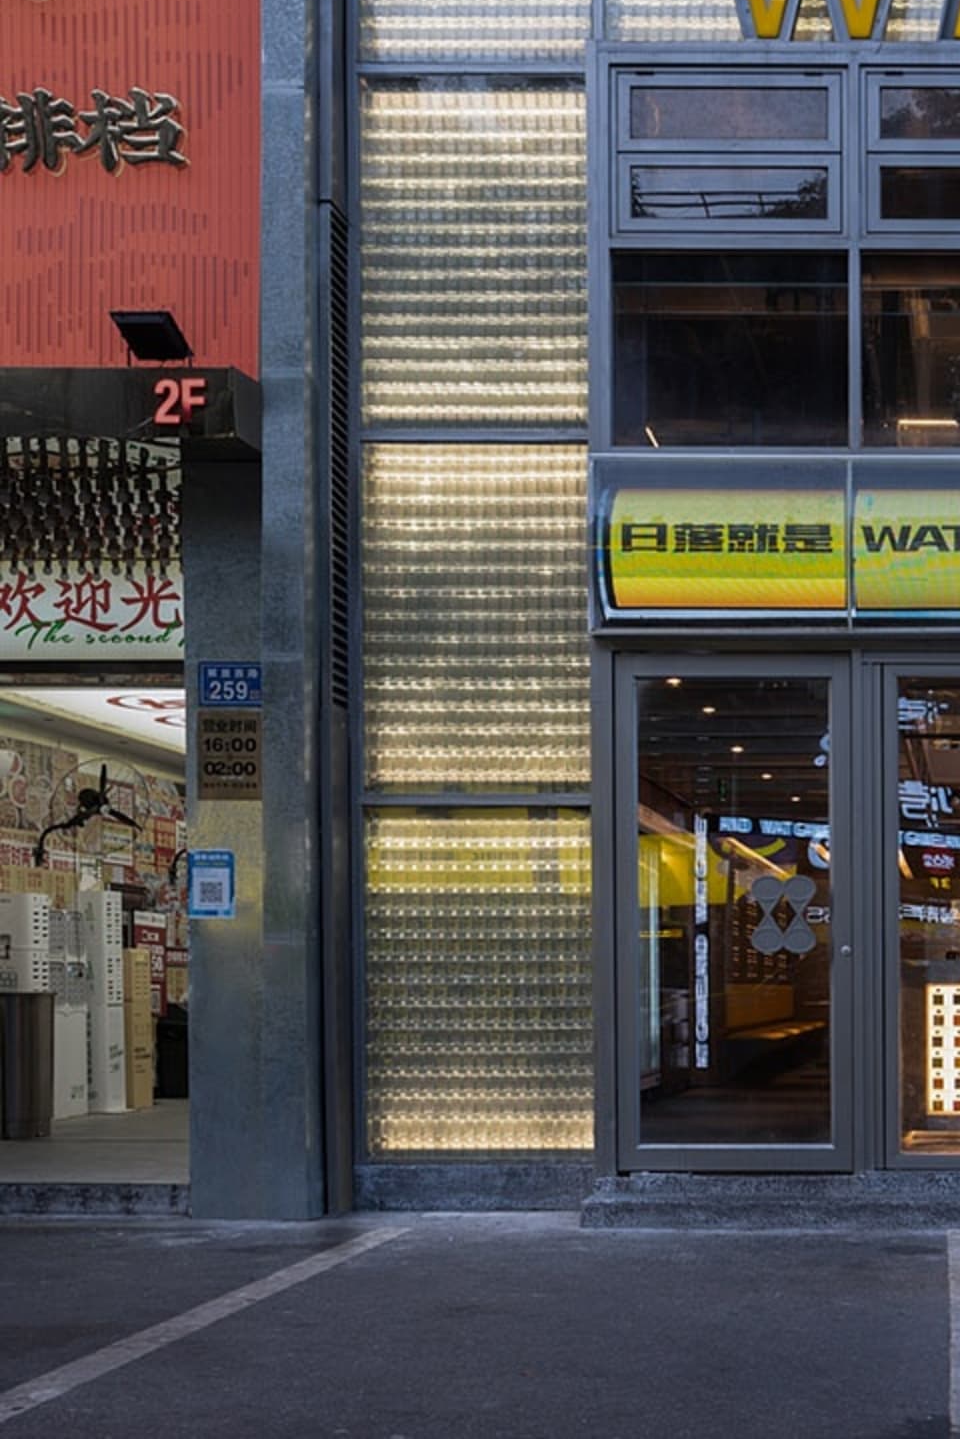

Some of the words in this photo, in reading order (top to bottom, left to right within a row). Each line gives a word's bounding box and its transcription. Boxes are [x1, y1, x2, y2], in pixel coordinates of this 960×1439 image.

[154, 377, 206, 424] 2F
[621, 523, 832, 553] 日落就是
[209, 681, 249, 700] 259
[203, 738, 257, 752] 16:00
[203, 761, 257, 776] 02:00
